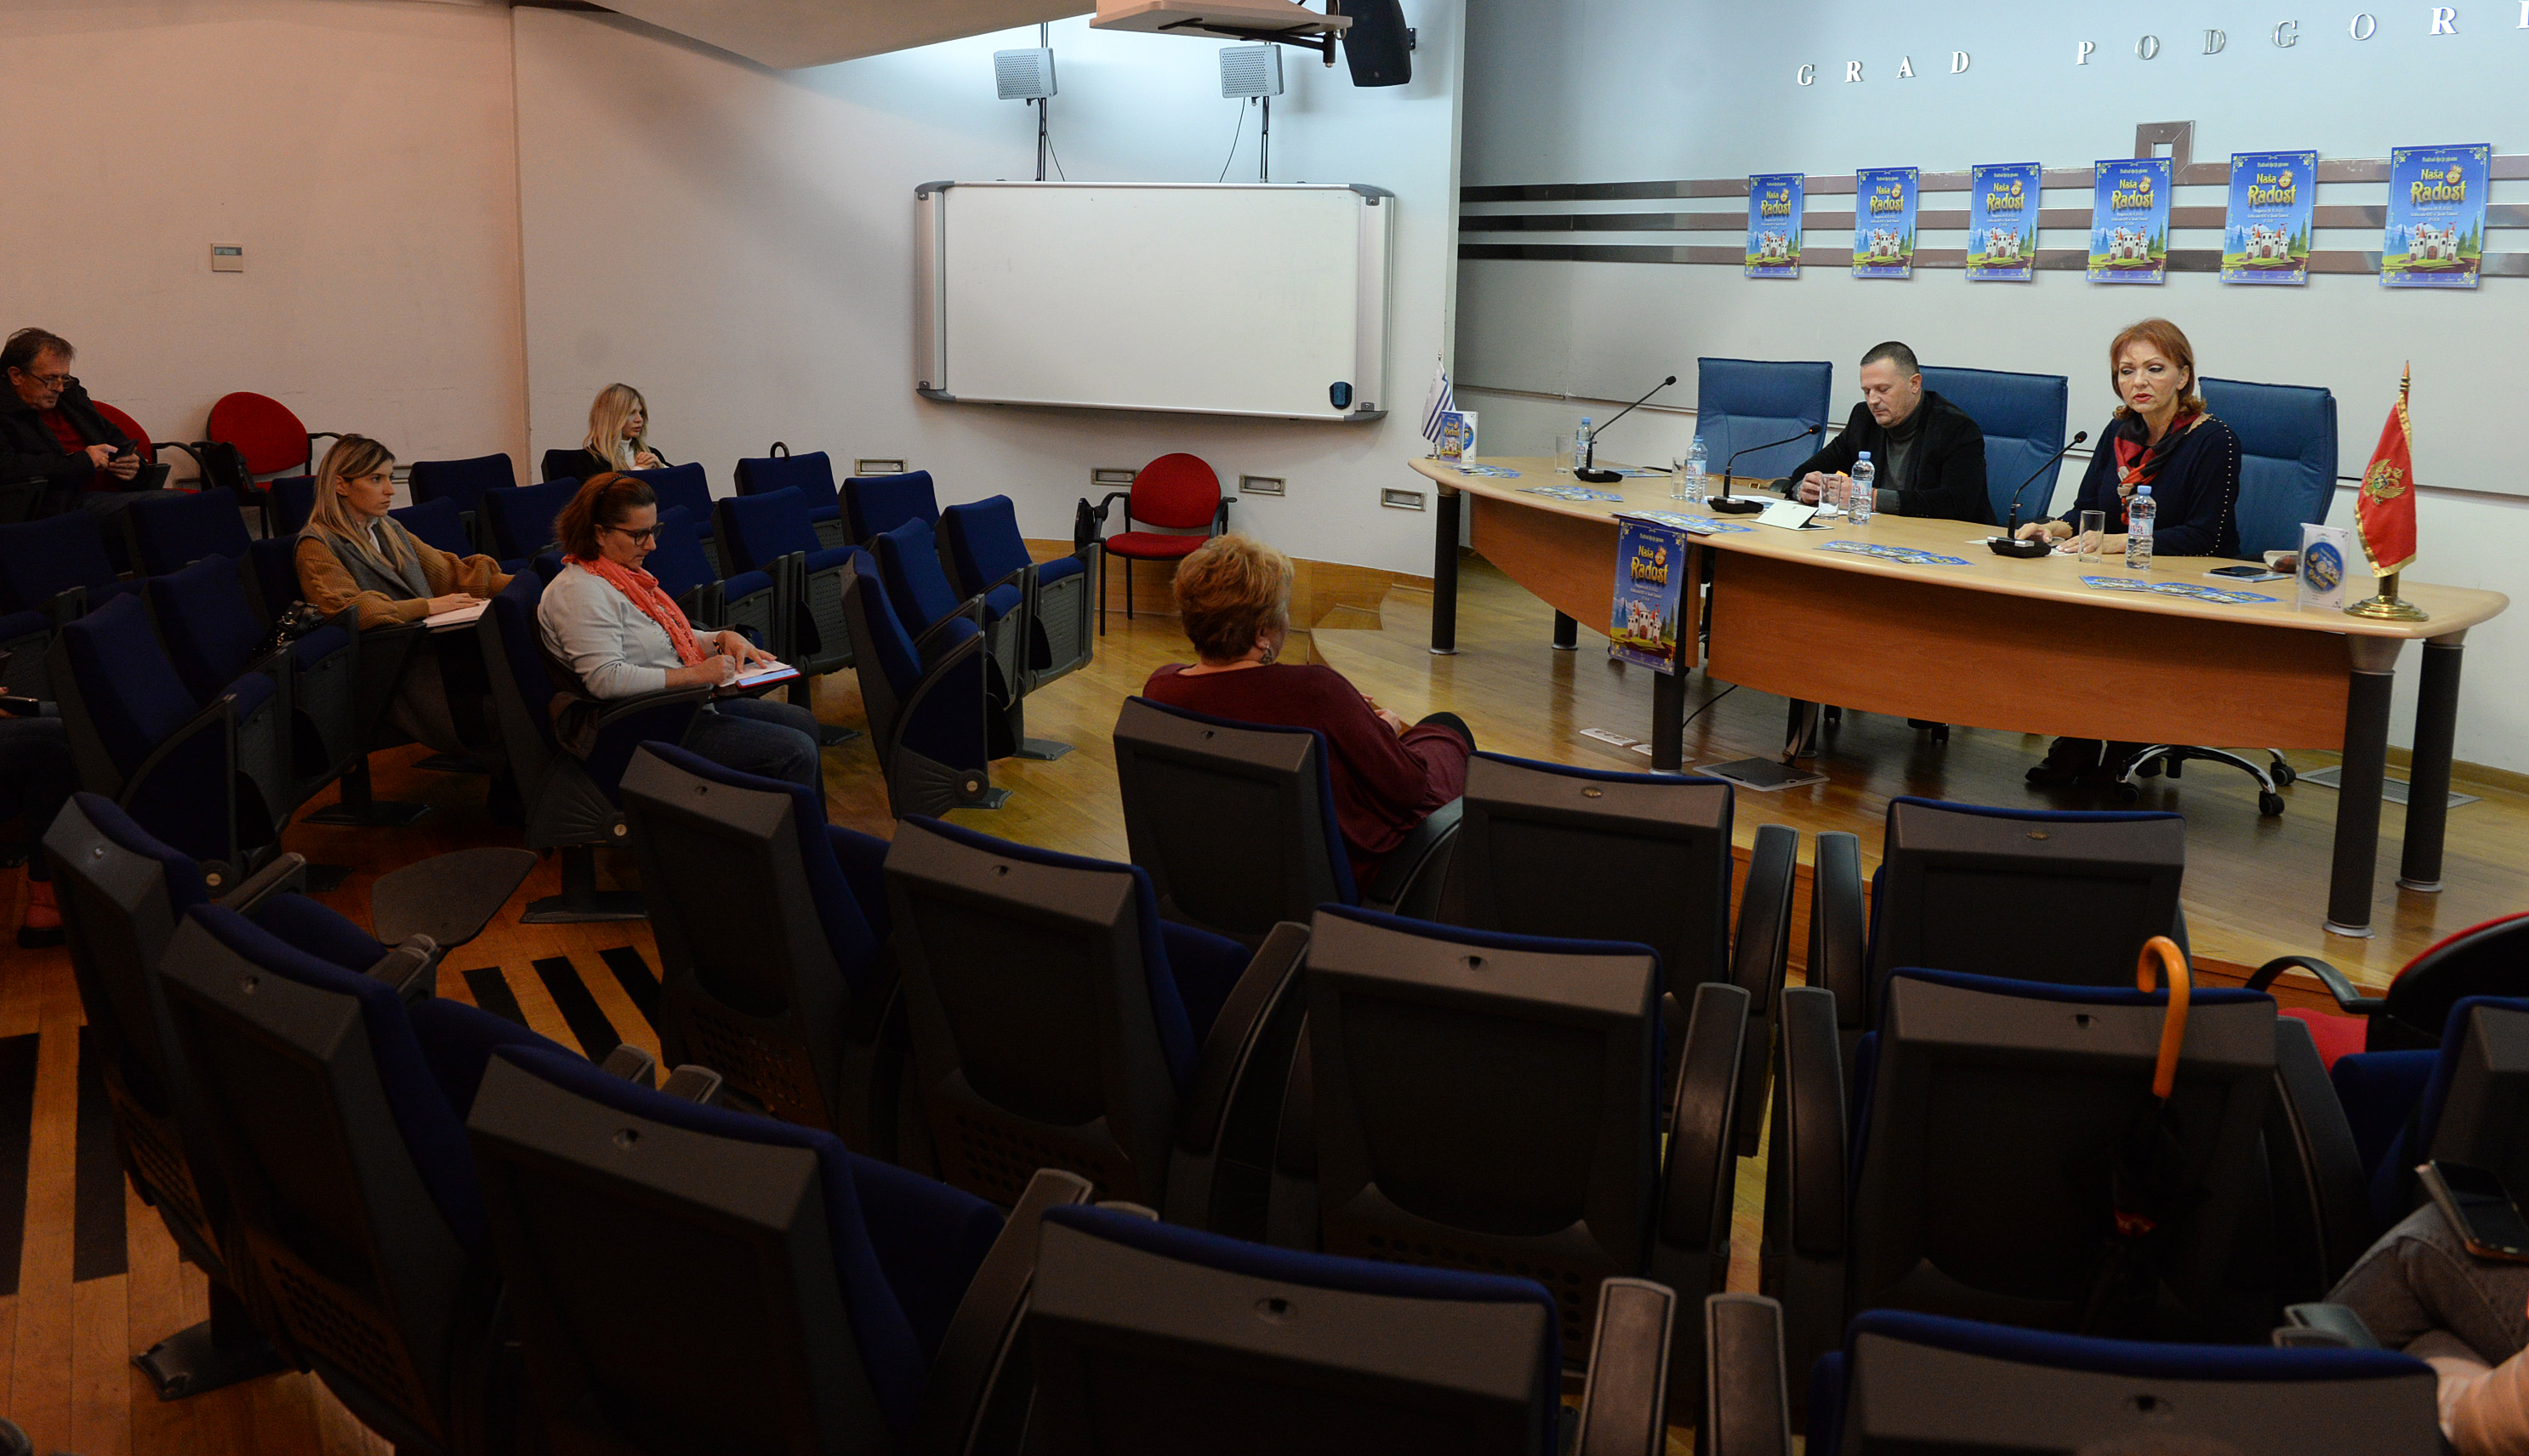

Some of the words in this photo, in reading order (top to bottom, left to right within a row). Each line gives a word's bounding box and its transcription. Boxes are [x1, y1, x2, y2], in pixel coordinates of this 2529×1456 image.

[1797, 50, 1971, 86] GRAD
[2256, 173, 2277, 185] Naša
[2420, 168, 2444, 180] Naša
[1986, 192, 2025, 212] Radost
[2111, 189, 2155, 211] Radost
[2247, 184, 2297, 207] Radost
[2410, 180, 2467, 204] Radost
[1761, 199, 1791, 216] Radost
[1870, 195, 1905, 213] Radost
[1631, 556, 1669, 585] Radost
